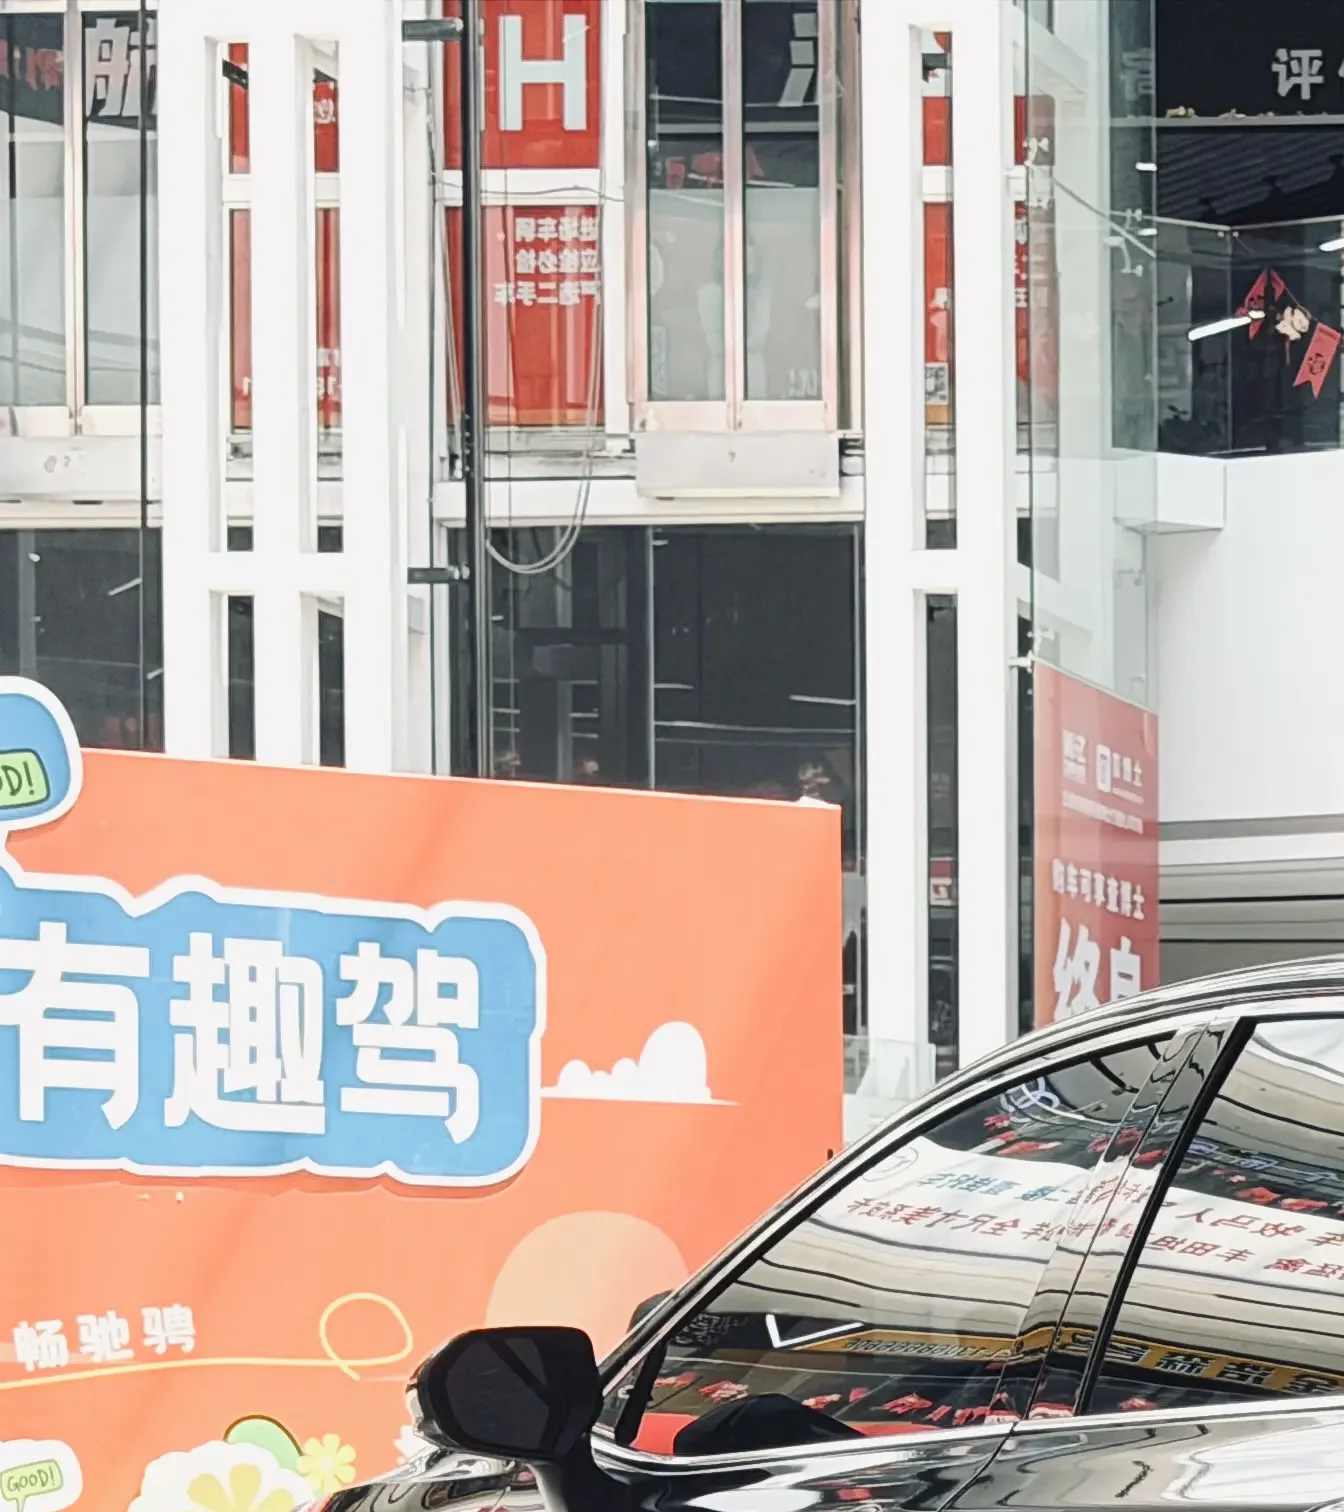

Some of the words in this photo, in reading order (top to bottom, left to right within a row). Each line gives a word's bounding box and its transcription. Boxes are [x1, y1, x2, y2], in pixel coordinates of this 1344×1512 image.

[0, 760, 35, 797] D!
[0, 922, 481, 1145] 有趣驾
[12, 1303, 196, 1372] 畅驰骋
[7, 1467, 55, 1492] GOOD!
